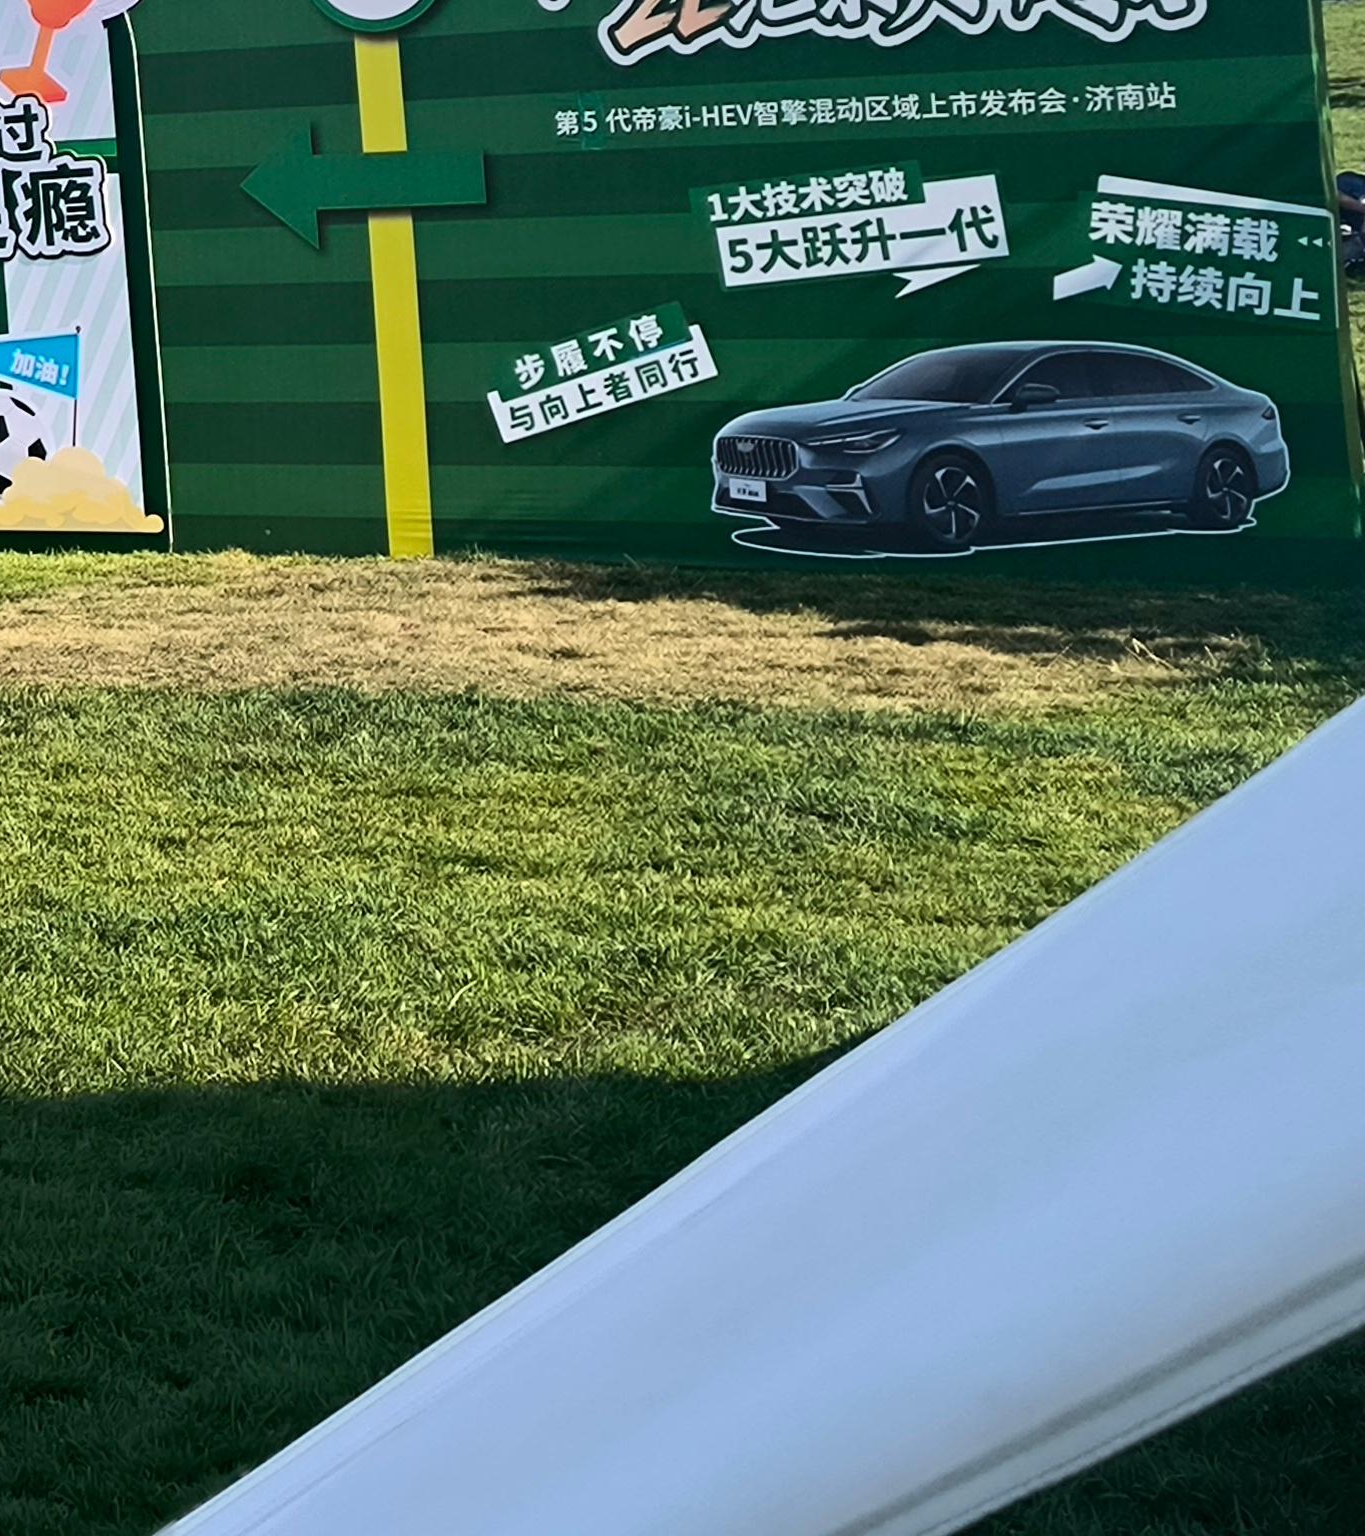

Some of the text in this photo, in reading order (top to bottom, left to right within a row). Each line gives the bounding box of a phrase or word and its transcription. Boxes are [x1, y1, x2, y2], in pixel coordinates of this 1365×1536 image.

[707, 167, 908, 222] 1大技术突破
[727, 204, 1000, 275] 5大跃升一代
[1088, 200, 1280, 263] 荣耀满载
[1130, 258, 1321, 321] 持续向上
[10, 348, 70, 386] 加油!
[514, 314, 664, 391] 步履不停
[509, 349, 699, 432] 与向上者同行
